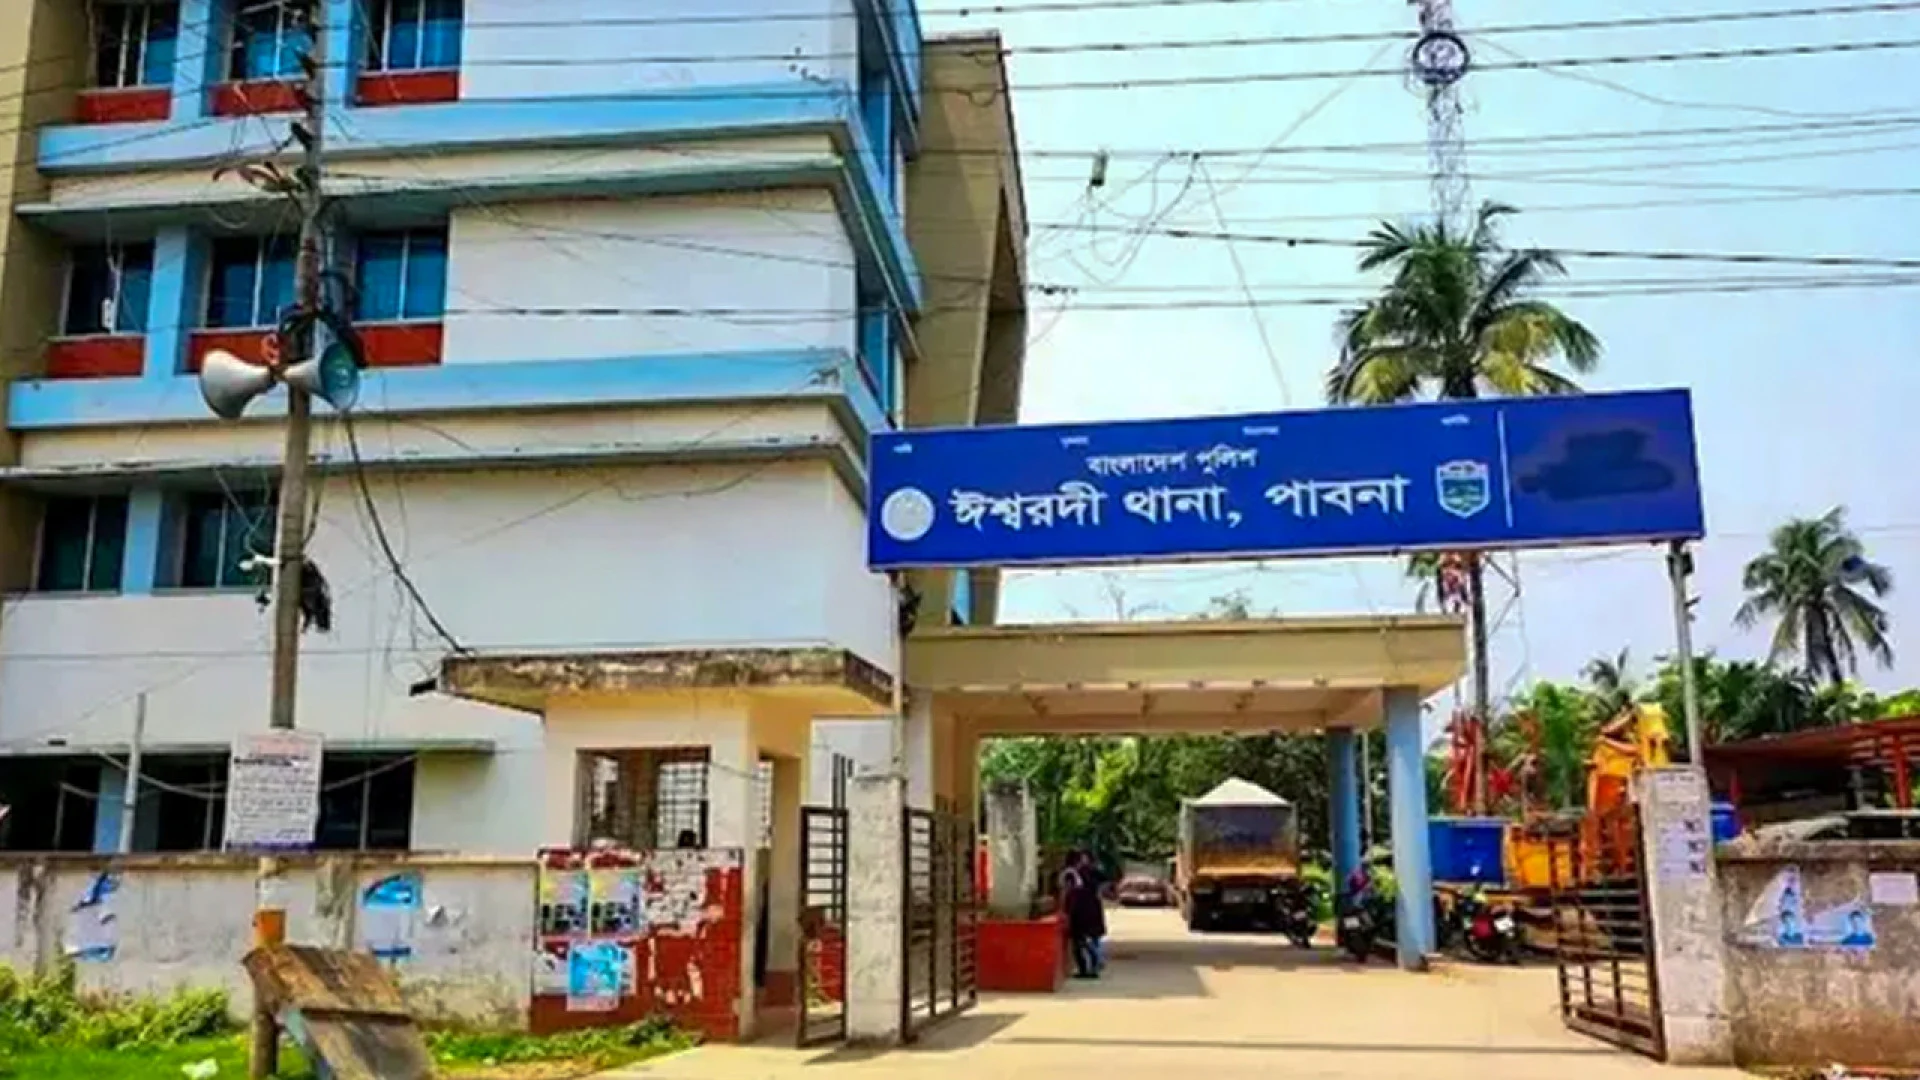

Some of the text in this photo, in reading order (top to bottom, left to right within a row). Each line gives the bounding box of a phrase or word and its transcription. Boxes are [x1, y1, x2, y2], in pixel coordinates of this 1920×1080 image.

[1086, 443, 1258, 476] বাংলাদেশ পুলিশ
[948, 474, 1412, 532] ঈশ্বরদী থানা, পাবনা
